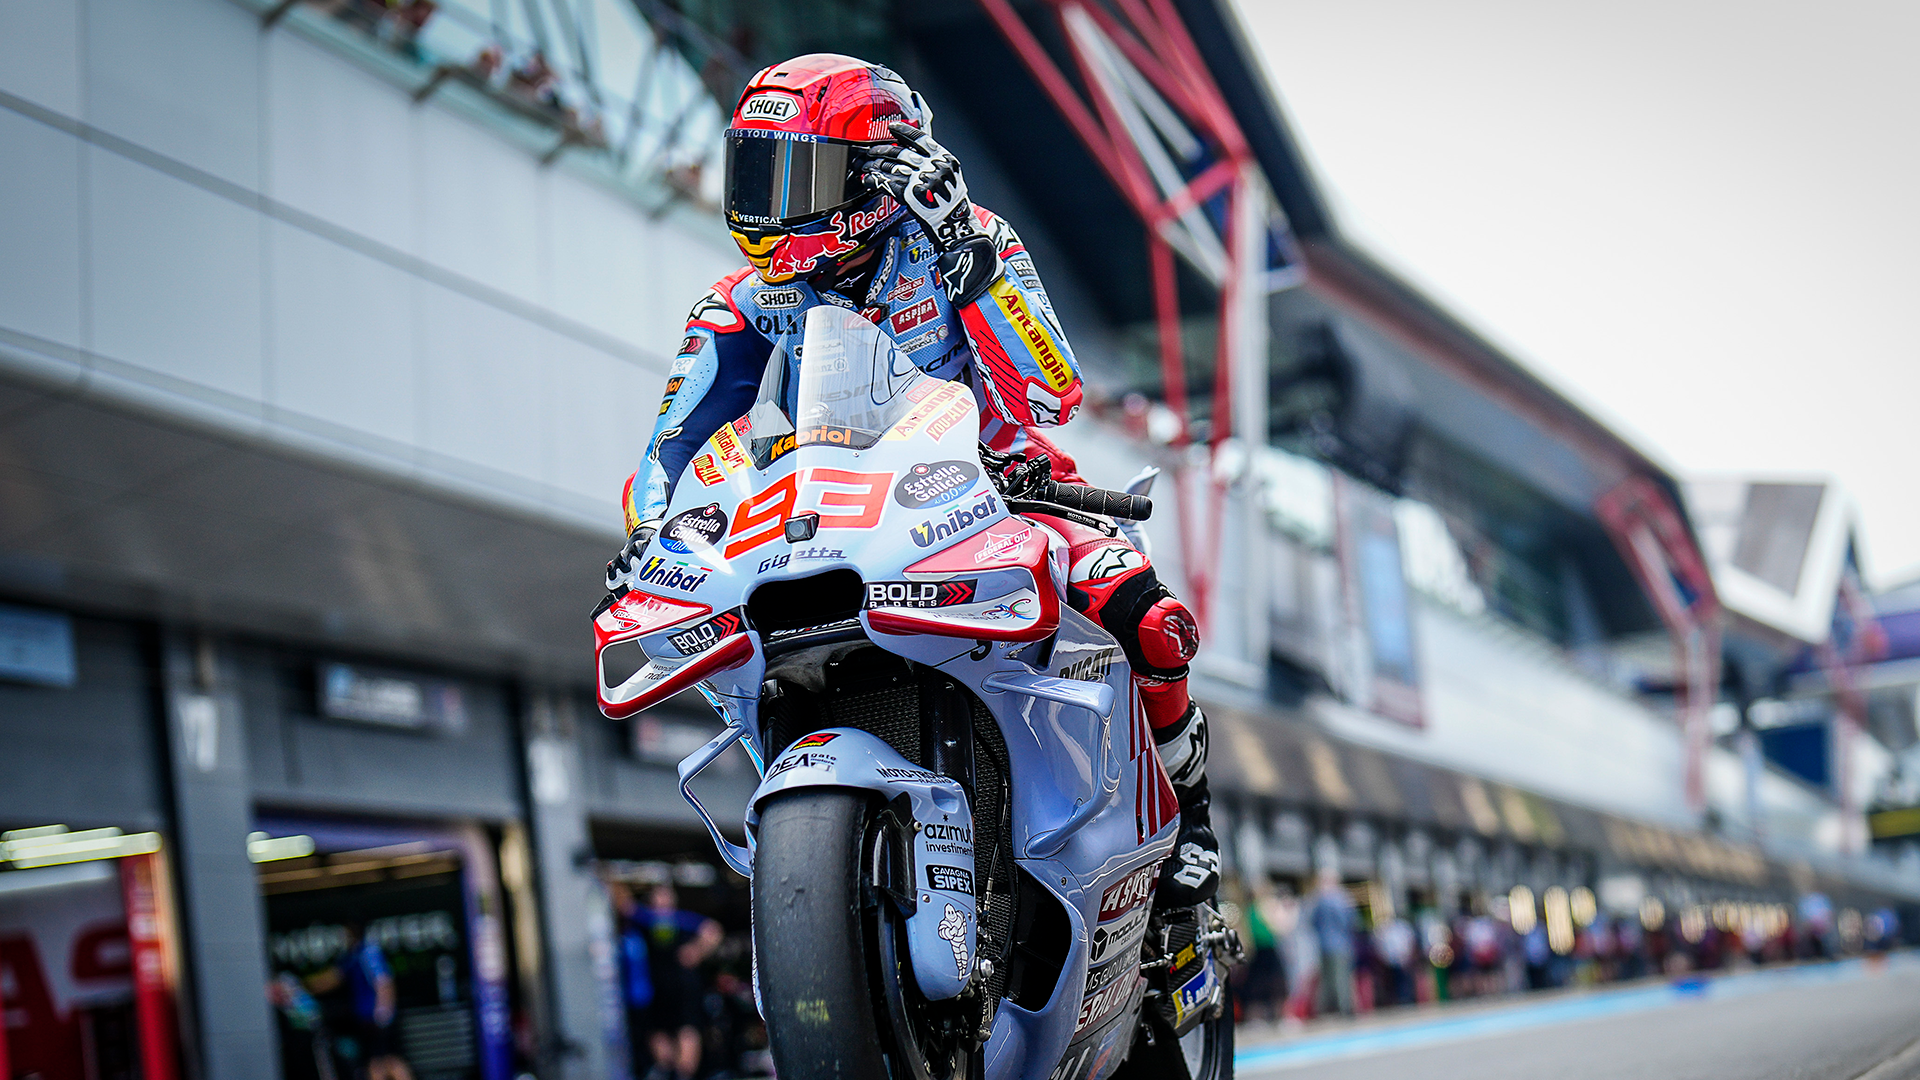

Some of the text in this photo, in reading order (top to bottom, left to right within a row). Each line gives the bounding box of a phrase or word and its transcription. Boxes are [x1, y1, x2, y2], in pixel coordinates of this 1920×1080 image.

[746, 99, 790, 117] SHOEI
[747, 130, 769, 138] YOU
[773, 132, 818, 143] WINGS
[739, 213, 782, 224] VERTICAL
[849, 195, 889, 237] Red
[760, 291, 799, 306] SHOEI
[1000, 293, 1068, 389] Antangin
[895, 382, 964, 437] Antangin
[927, 397, 974, 438] YOU-ALL
[903, 464, 961, 496] Estrella
[914, 473, 968, 502] Galicia
[677, 513, 721, 533] Estrella
[724, 467, 894, 560] 93
[909, 494, 998, 548] Unibat
[669, 525, 710, 544] Galicia
[977, 531, 1028, 560] FEDERAL OIL
[757, 546, 847, 574] Gigetta
[638, 556, 708, 593] Unibat
[869, 583, 938, 602] BOLD
[673, 623, 716, 650] BOLD
[683, 637, 719, 655] RIDERS
[924, 822, 973, 845] azimut
[932, 866, 970, 880] CAVAGNA
[934, 874, 972, 894] SIPEX
